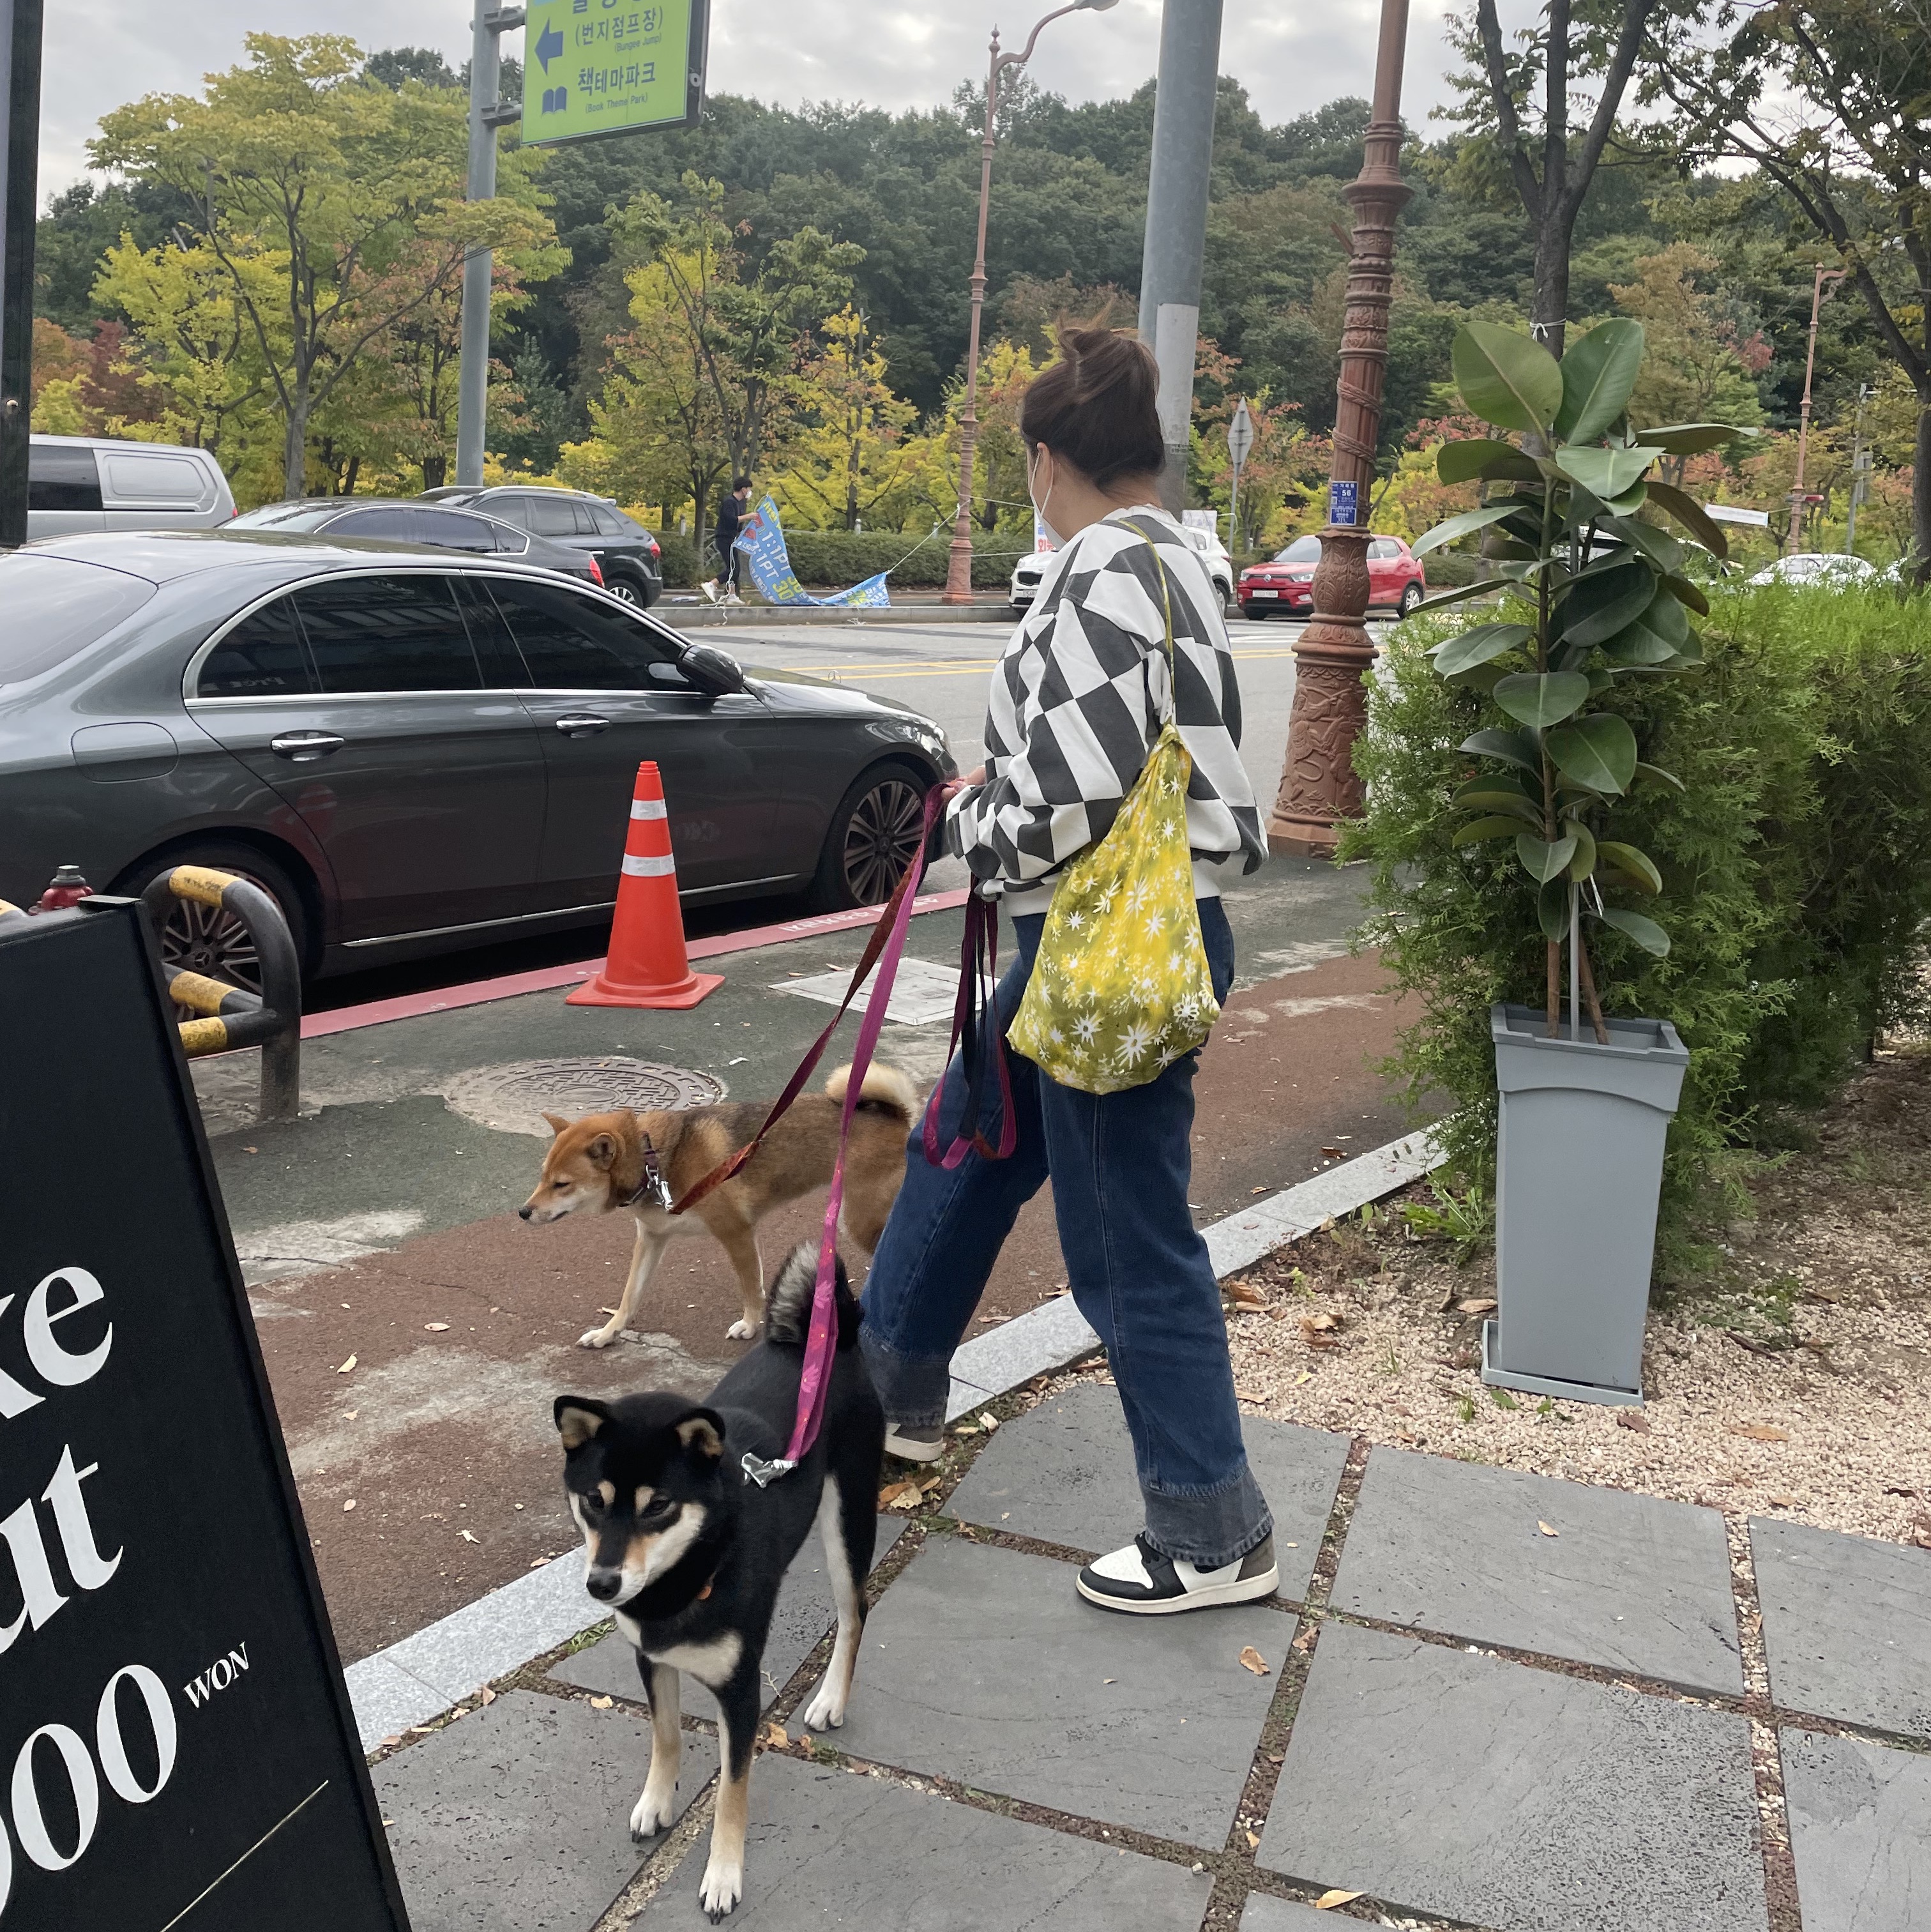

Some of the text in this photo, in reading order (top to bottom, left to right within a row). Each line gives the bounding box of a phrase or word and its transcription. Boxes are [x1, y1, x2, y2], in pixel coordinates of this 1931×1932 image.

[575, 6, 663, 47] (번지점프장)
[578, 62, 656, 96] 책테마파크
[586, 92, 647, 114] (Book Theme Park)
[0, 1642, 249, 1915] 00 WON
